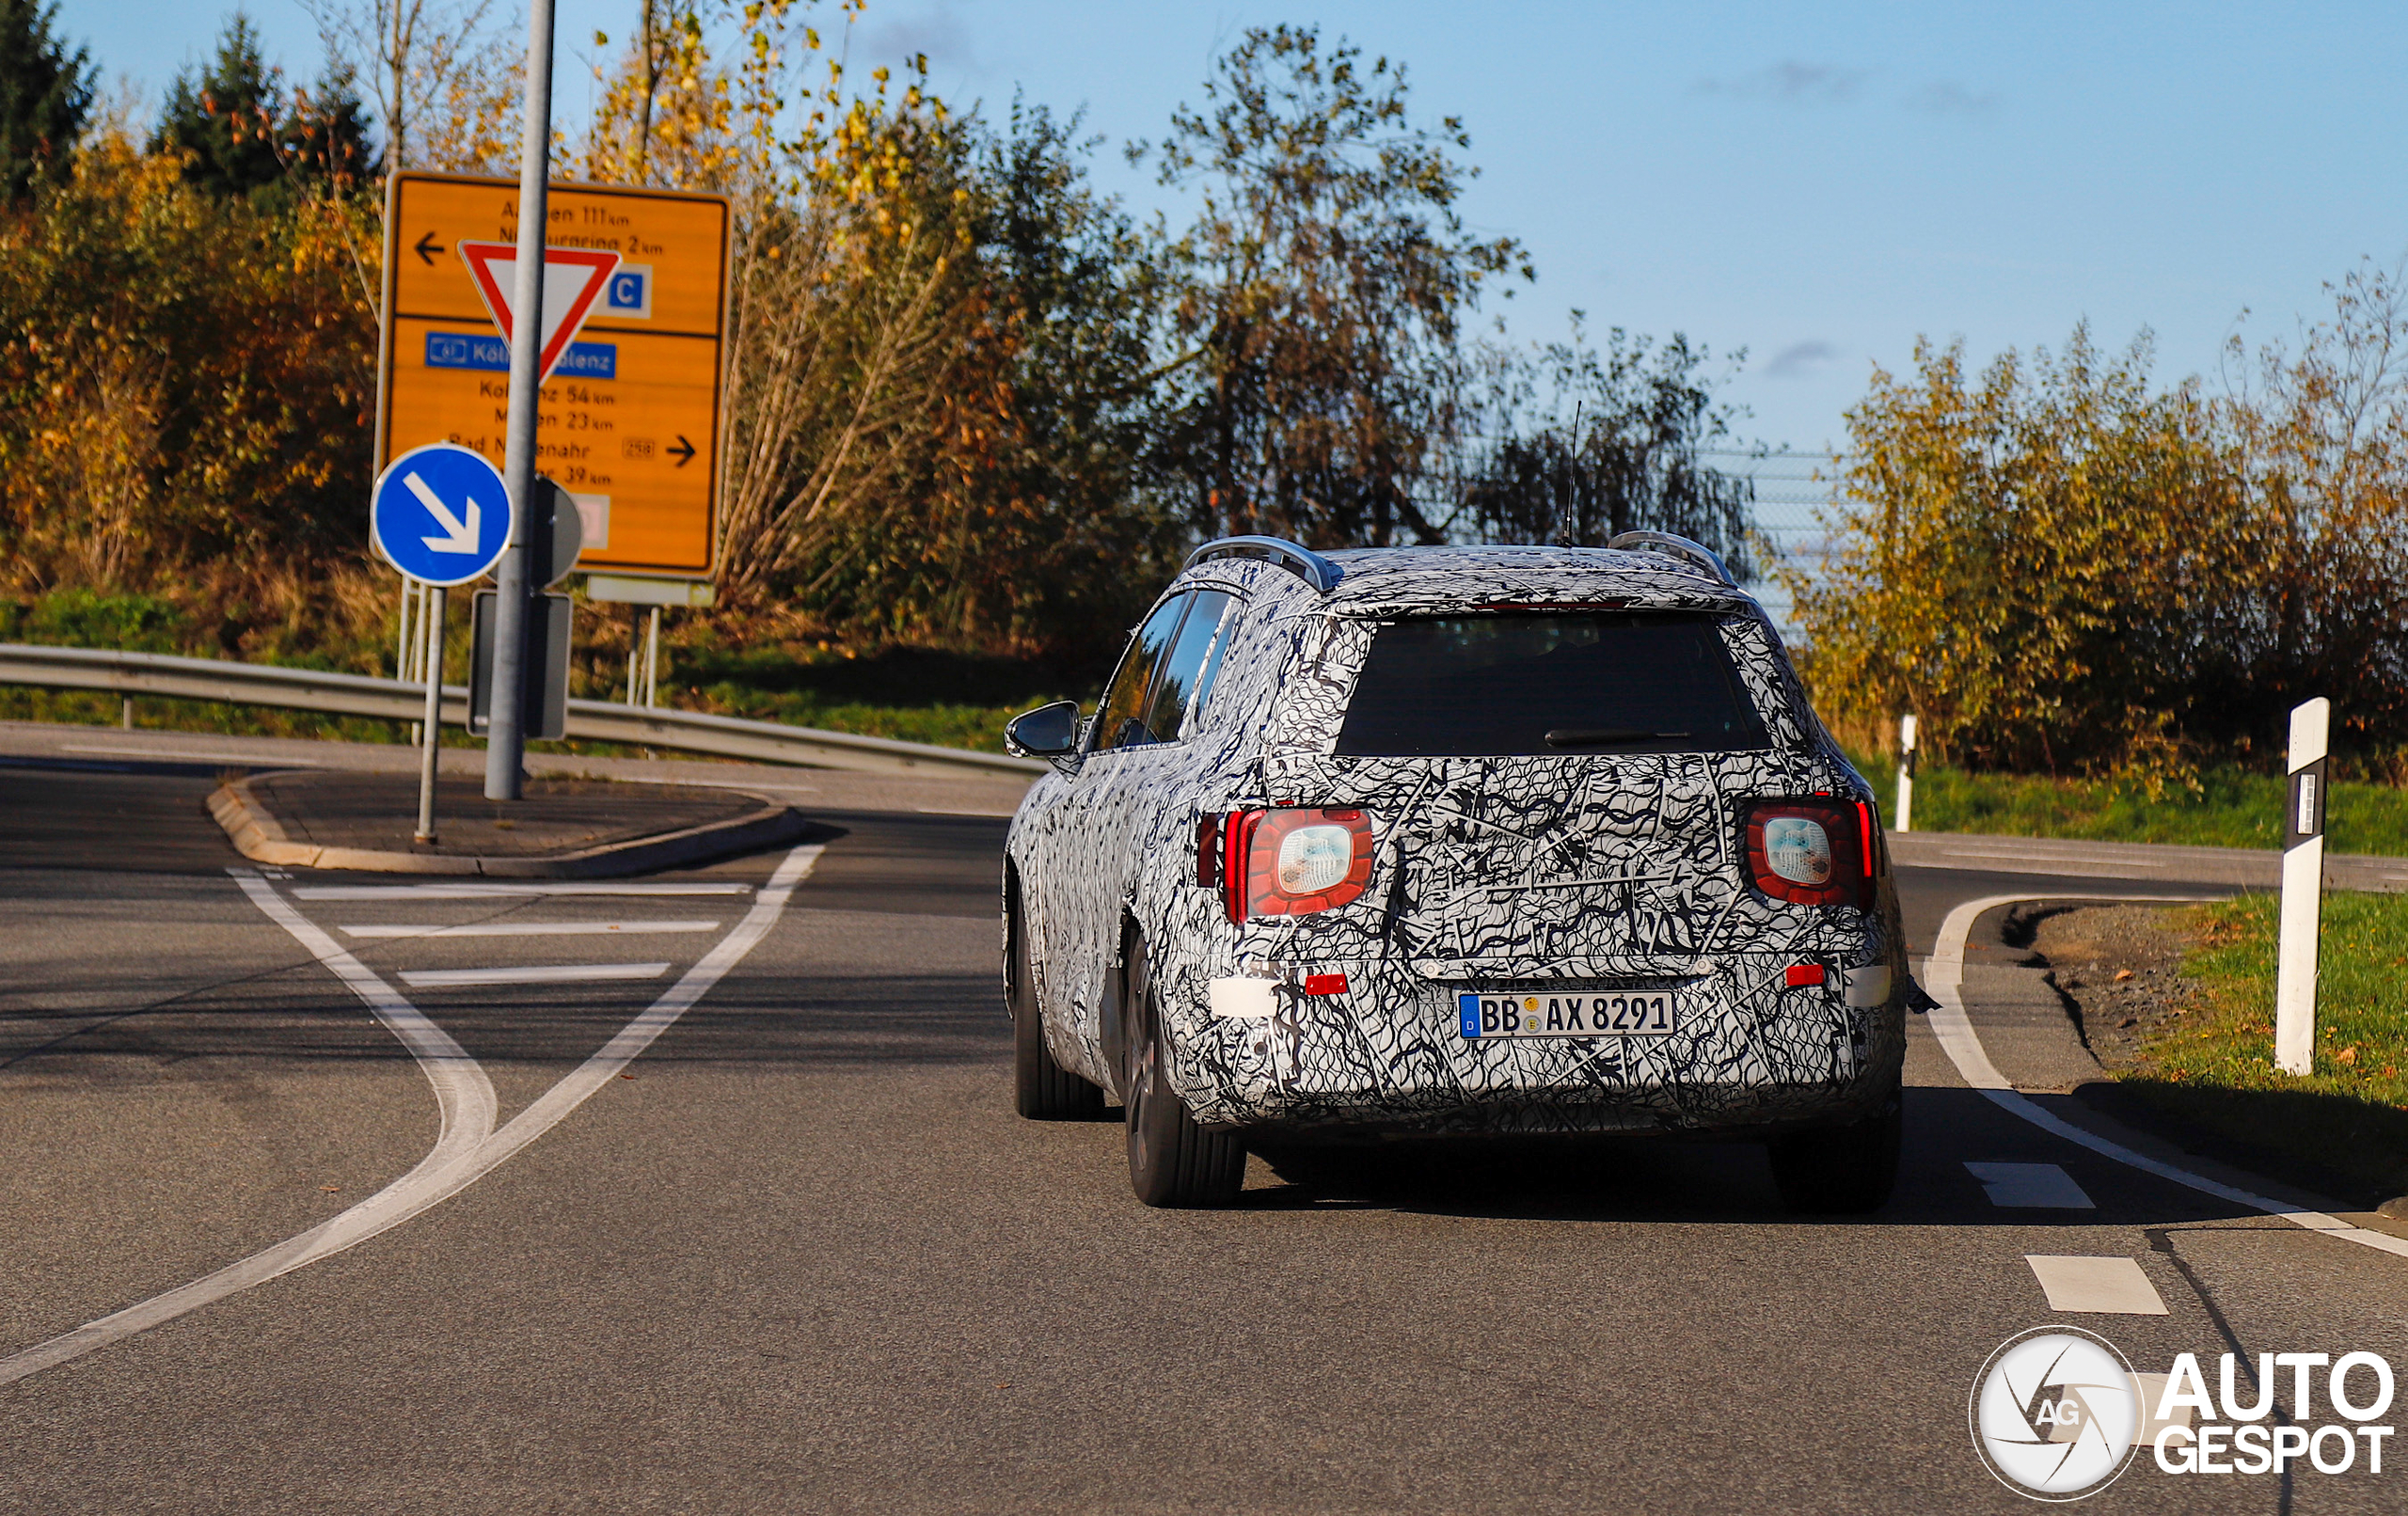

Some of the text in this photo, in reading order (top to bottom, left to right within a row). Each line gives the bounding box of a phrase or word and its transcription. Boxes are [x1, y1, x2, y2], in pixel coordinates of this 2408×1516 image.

[615, 276, 634, 304] C
[566, 385, 590, 403] 54
[593, 390, 614, 405] km
[566, 411, 589, 430] 23
[592, 417, 613, 432] km
[589, 470, 611, 485] km
[1481, 997, 1669, 1032] BB AX 8291
[1465, 1020, 1474, 1032] D
